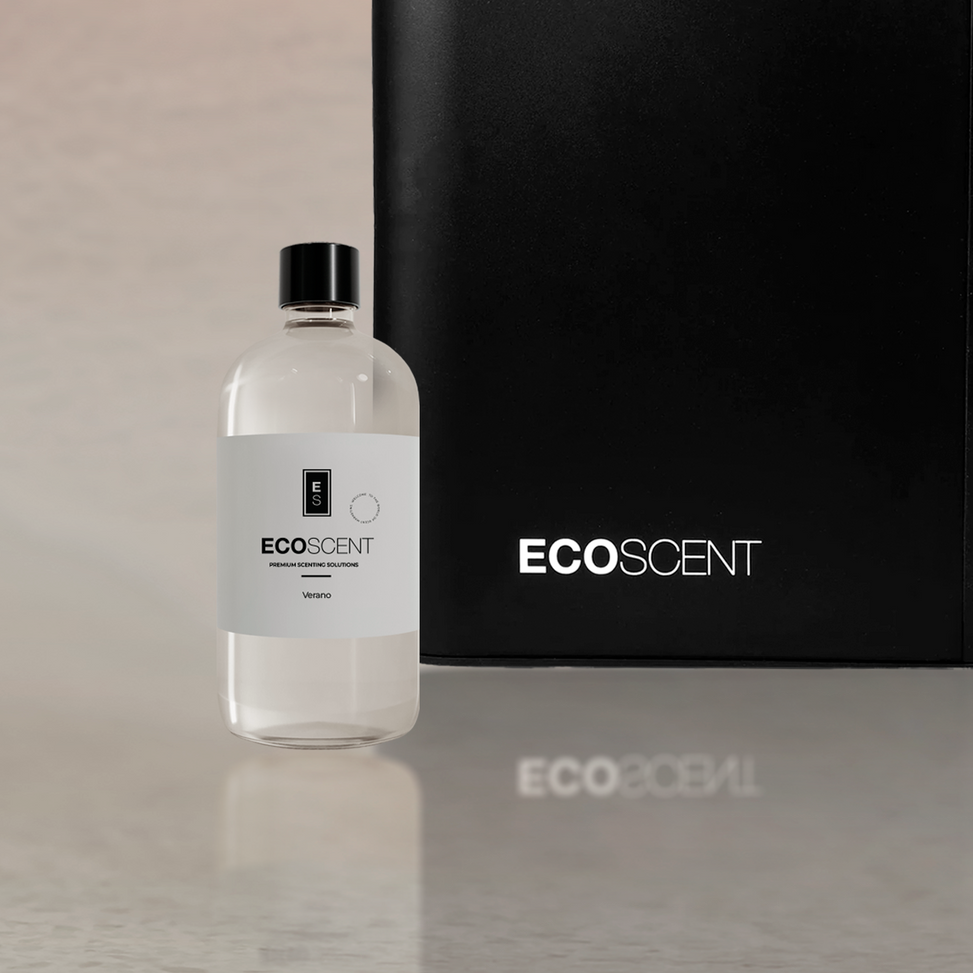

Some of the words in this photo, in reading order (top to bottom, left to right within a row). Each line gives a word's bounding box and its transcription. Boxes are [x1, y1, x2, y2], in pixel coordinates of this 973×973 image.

[312, 481, 322, 493] E
[312, 494, 322, 507] S
[261, 537, 375, 555] ECOSCENT
[518, 538, 763, 576] ECOSCENT
[301, 591, 332, 600] Verano
